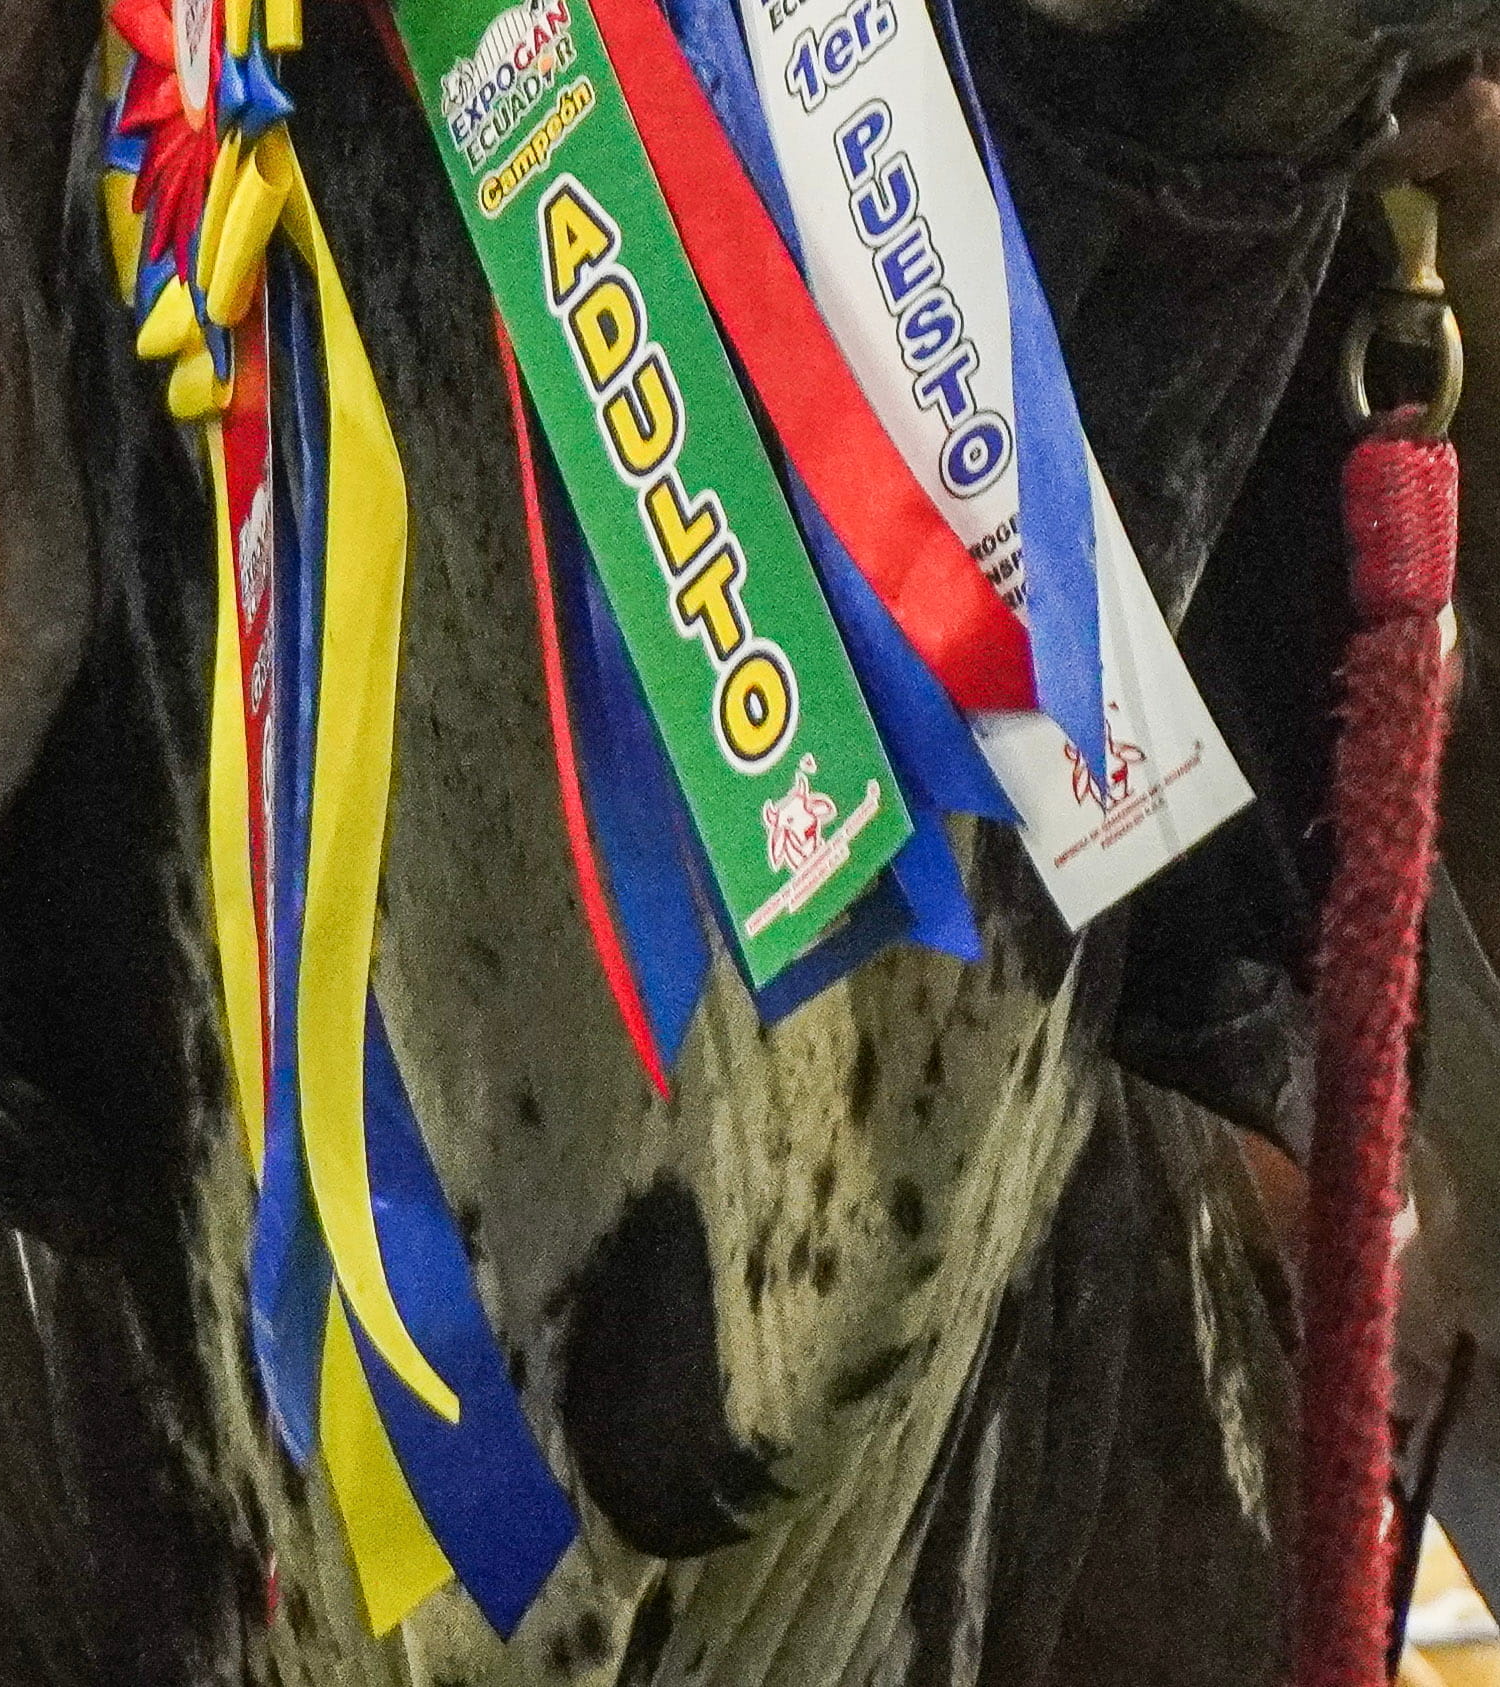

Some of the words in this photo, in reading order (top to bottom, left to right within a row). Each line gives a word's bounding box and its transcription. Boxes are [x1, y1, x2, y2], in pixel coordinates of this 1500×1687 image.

[480, 80, 594, 212] Campeón
[838, 105, 1008, 493] PUESTO
[541, 181, 793, 764] ADULTO
